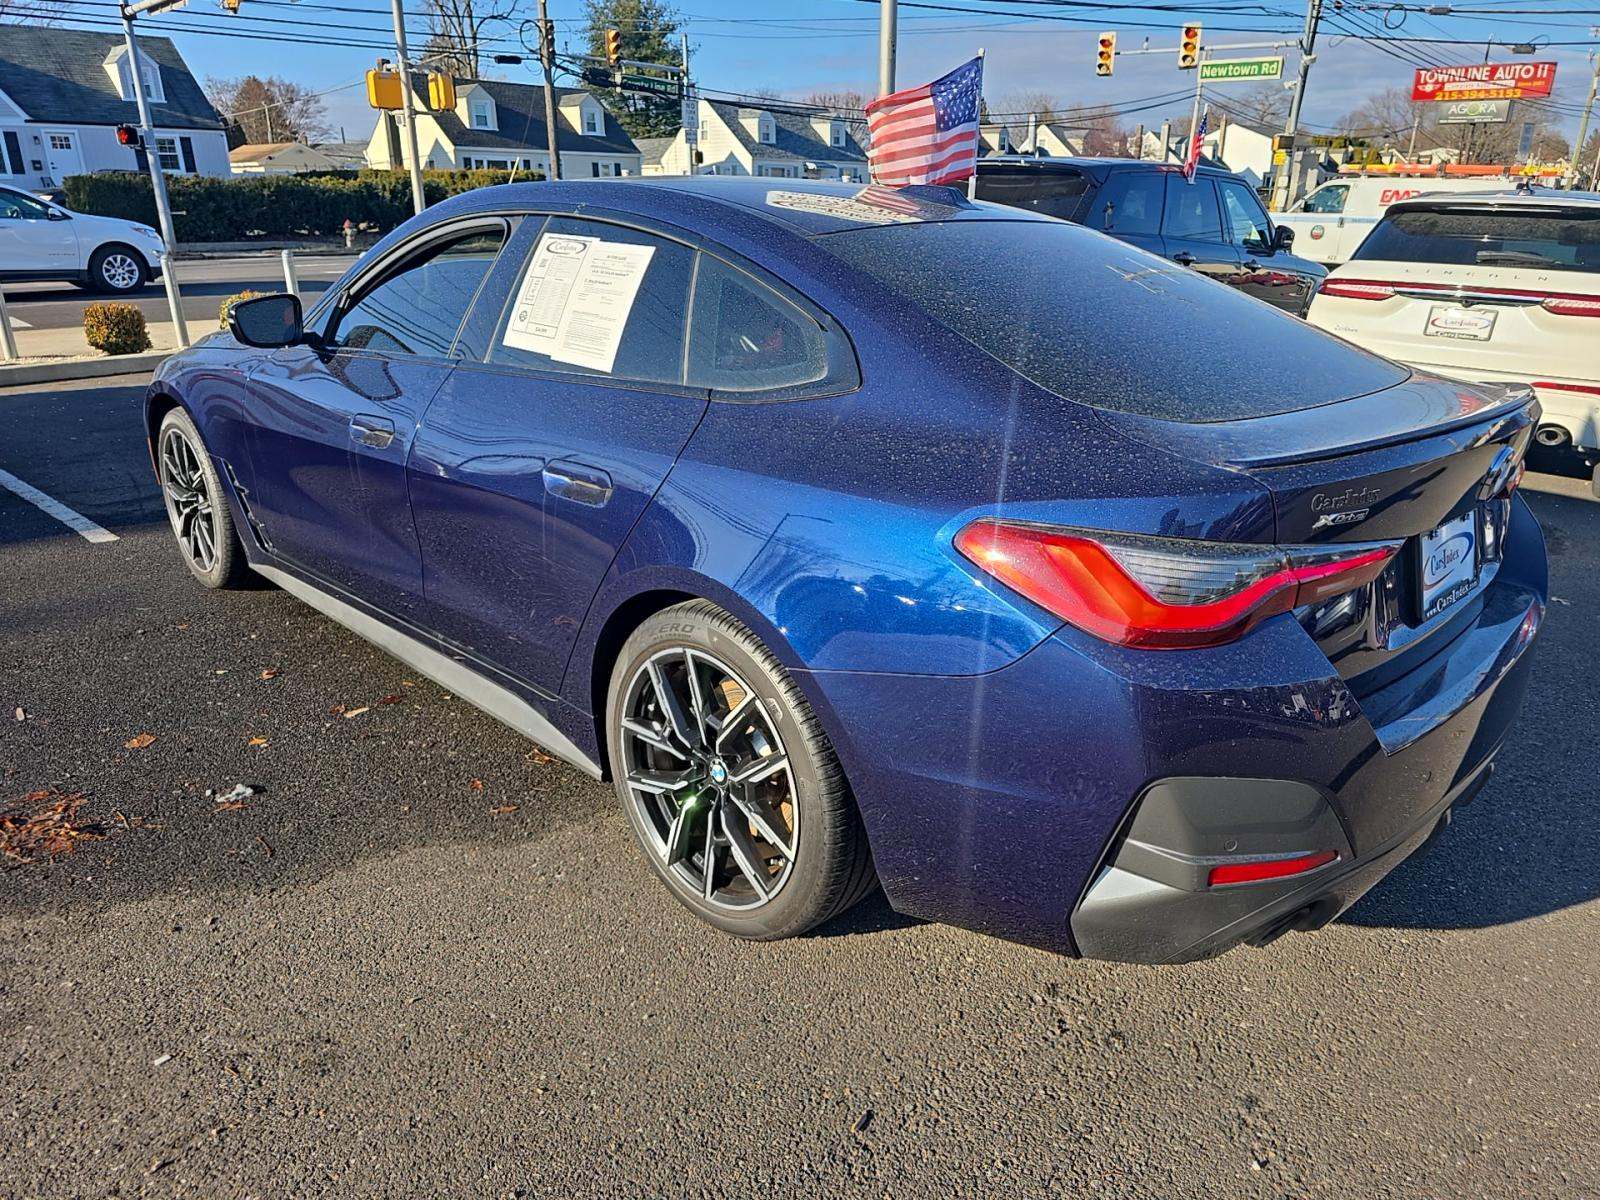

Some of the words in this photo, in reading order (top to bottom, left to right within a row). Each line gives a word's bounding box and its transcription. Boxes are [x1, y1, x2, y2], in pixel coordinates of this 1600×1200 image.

[1202, 63, 1258, 78] Newtown
[1260, 62, 1278, 75] Rd
[1419, 66, 1492, 84] TOWNLINE
[1494, 65, 1535, 81] AUTO
[622, 78, 649, 89] nty
[666, 84, 676, 93] Rd
[1434, 88, 1521, 100] 215-394-5153
[1448, 102, 1497, 115] AGORA
[1404, 268, 1548, 281] LINCOLN
[1430, 549, 1460, 576] CarsIndex
[1426, 580, 1478, 618] www.CarsIndex.com
[644, 621, 695, 636] ERO
